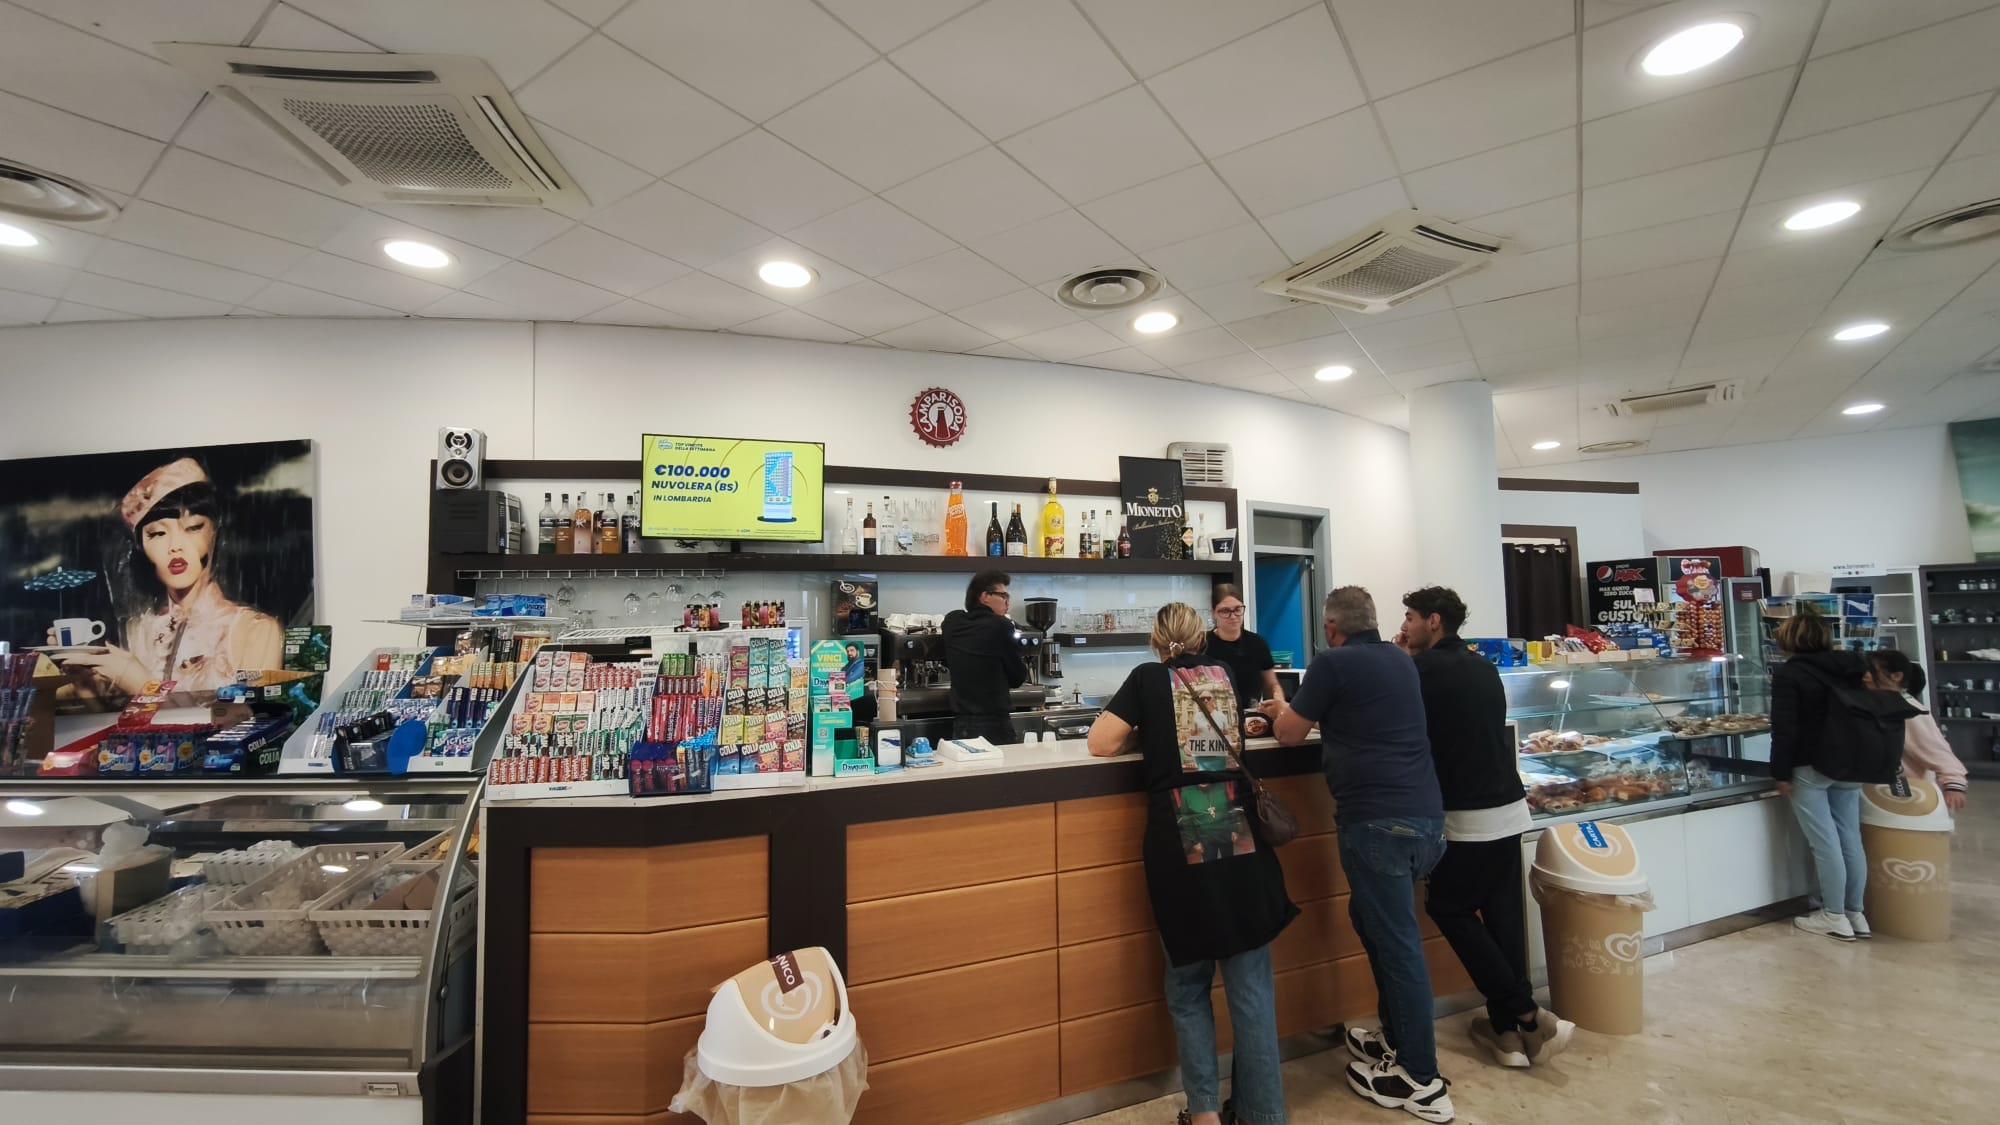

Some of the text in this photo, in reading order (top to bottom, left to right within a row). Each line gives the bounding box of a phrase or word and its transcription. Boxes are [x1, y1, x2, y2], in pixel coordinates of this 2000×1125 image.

[654, 464, 730, 479] €100.000
[651, 481, 739, 493] NUVOLERA (BS)
[1126, 502, 1182, 518] MIONETTO
[1613, 600, 1634, 610] SUL
[1189, 739, 1206, 751] THE
